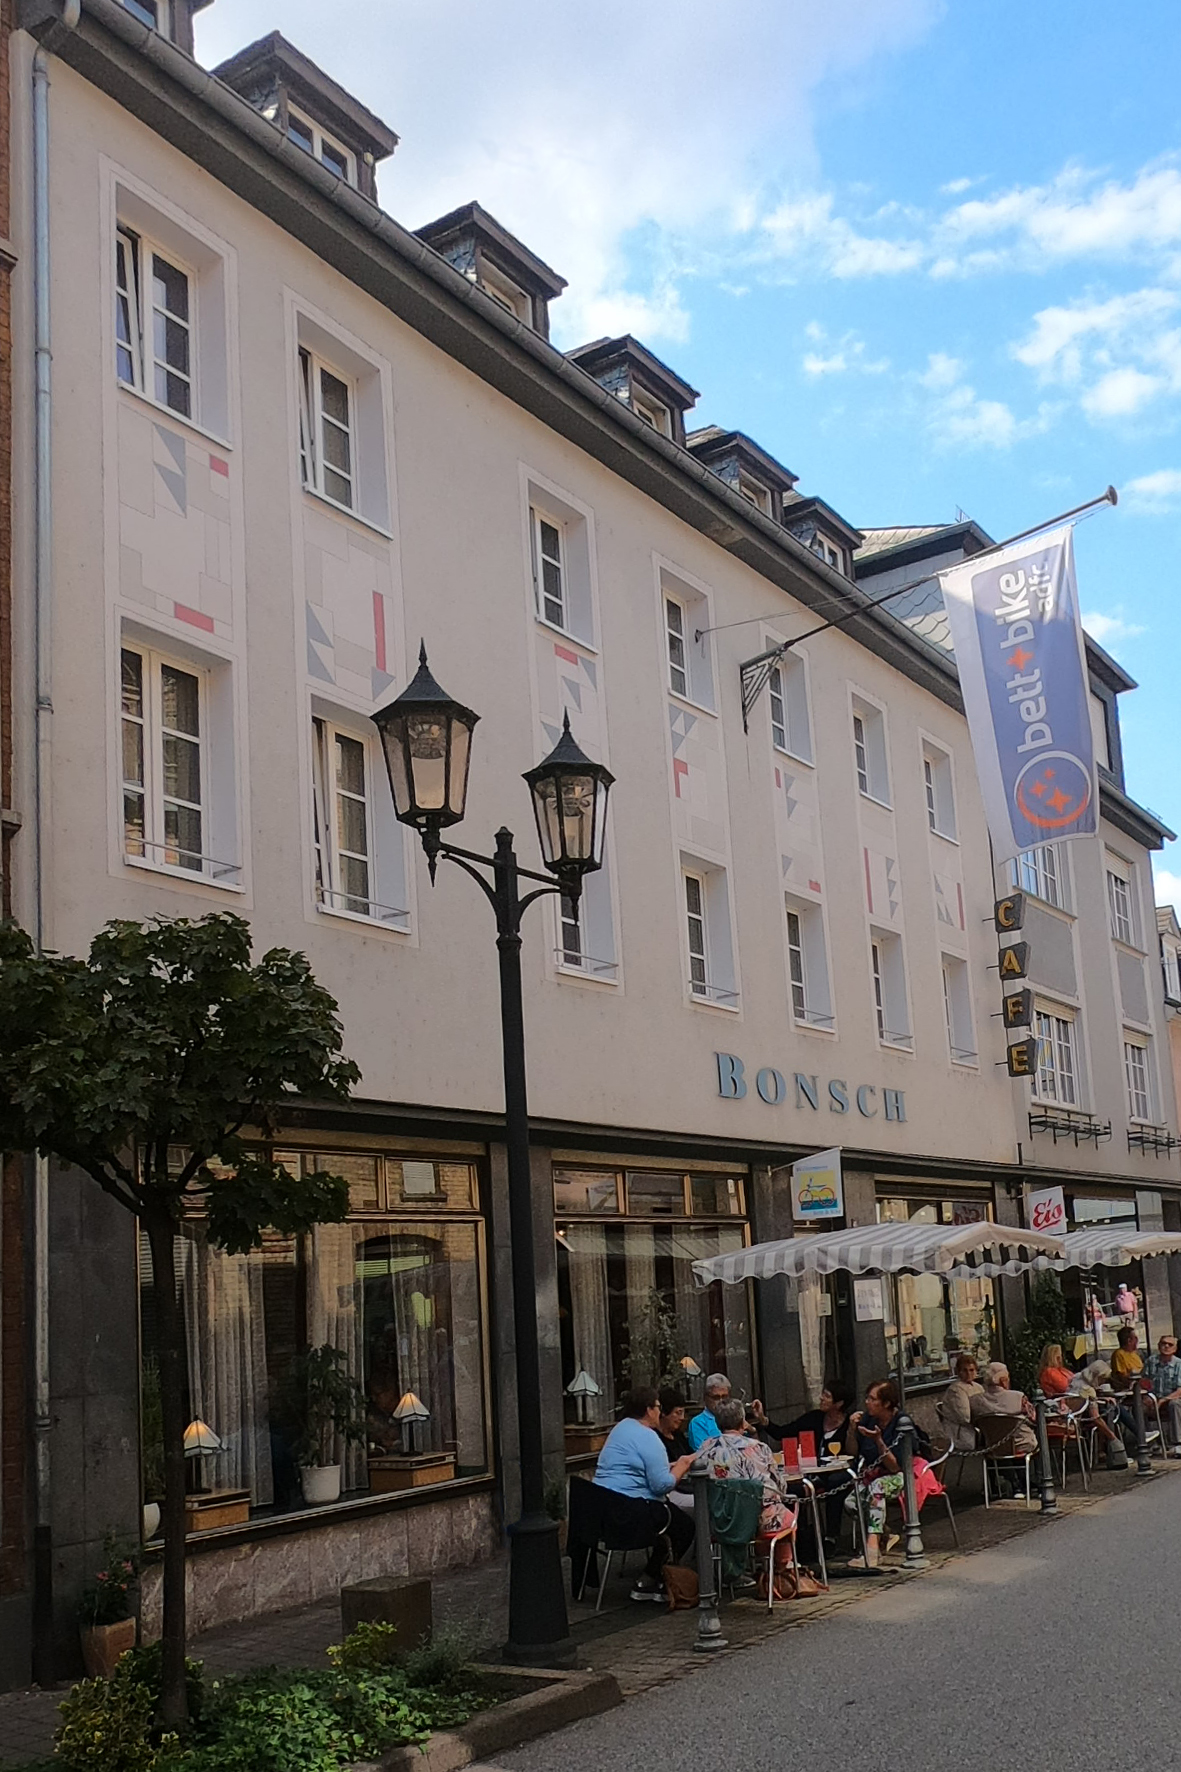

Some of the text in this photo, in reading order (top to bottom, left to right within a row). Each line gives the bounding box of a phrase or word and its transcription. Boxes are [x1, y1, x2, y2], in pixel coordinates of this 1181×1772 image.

[1028, 561, 1054, 617] adfc
[994, 568, 1055, 754] bett bike
[997, 900, 1030, 1073] CAFE
[713, 1051, 908, 1123] BONSCH
